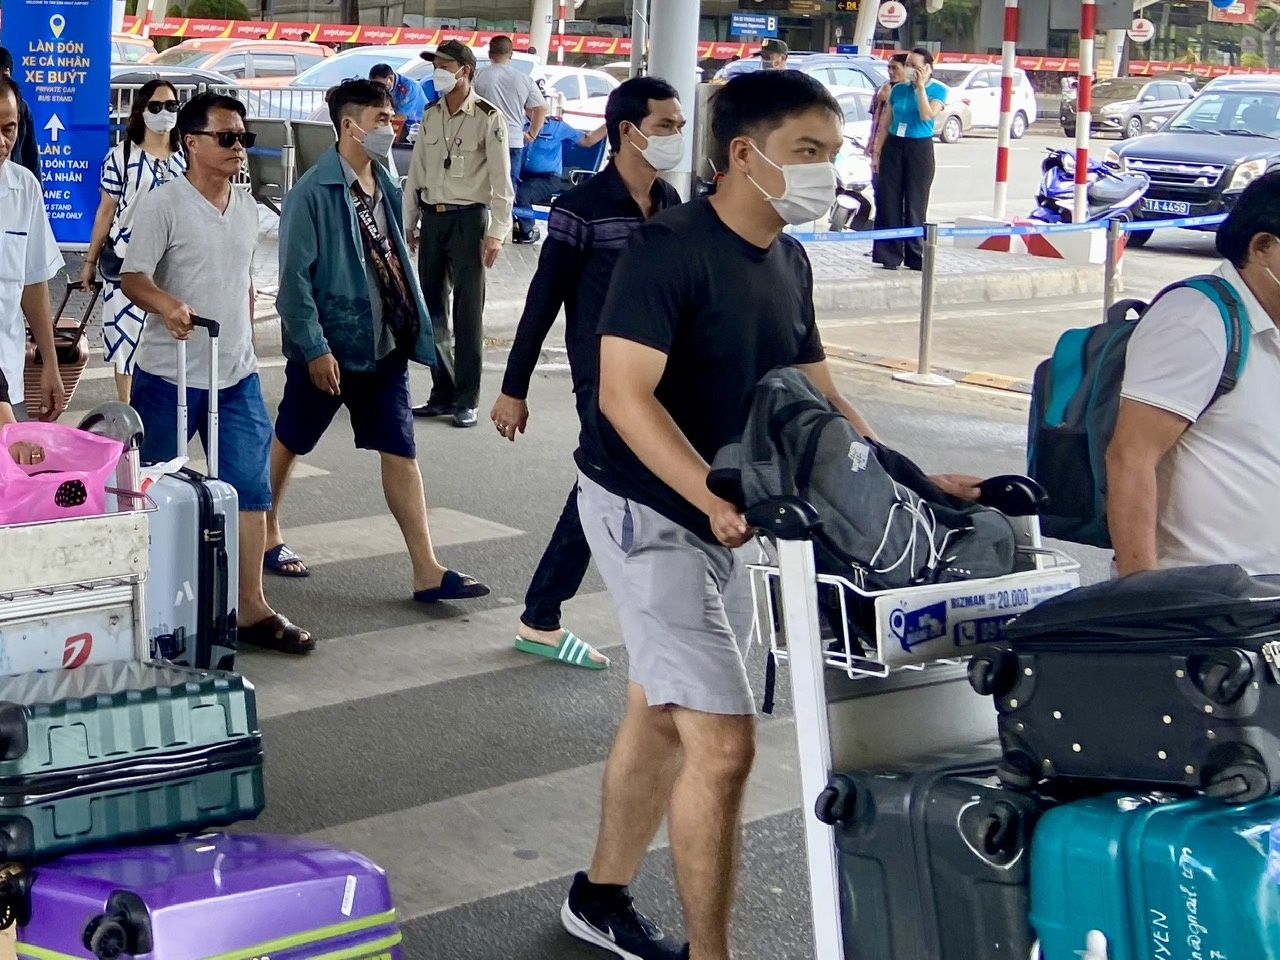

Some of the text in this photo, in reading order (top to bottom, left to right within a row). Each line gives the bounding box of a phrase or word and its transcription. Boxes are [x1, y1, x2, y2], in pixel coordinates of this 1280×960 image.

[768, 17, 776, 30] B
[29, 39, 84, 54] LÀN ĐÓN
[22, 55, 90, 68] XE CÁ NHÂN
[25, 69, 86, 84] XE BUÝT
[38, 143, 72, 155] LÀN C
[45, 158, 88, 168] ĐÓN TAXI
[55, 171, 82, 182] NHÂN
[44, 190, 62, 198] ANE
[950, 595, 986, 609] BIZMAN
[997, 588, 1028, 609] 20.000
